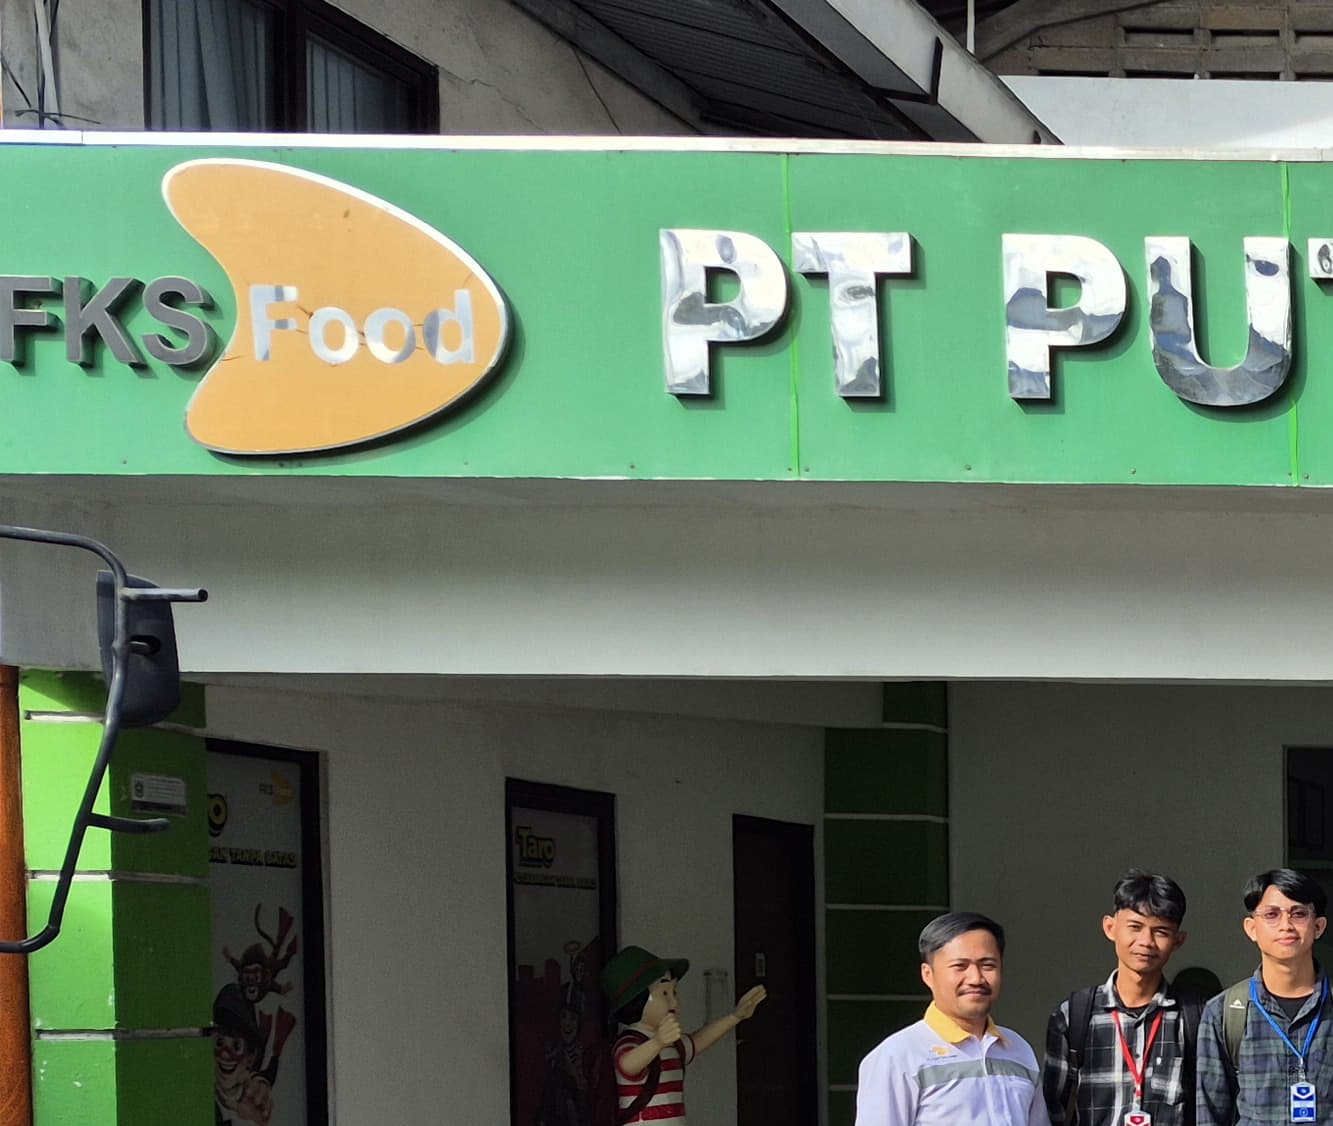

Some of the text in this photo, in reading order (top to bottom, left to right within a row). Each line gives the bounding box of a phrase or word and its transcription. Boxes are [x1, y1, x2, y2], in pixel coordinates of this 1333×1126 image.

[0, 276, 477, 367] FKS Food
[659, 228, 914, 402] PT
[516, 826, 555, 864] Taro
